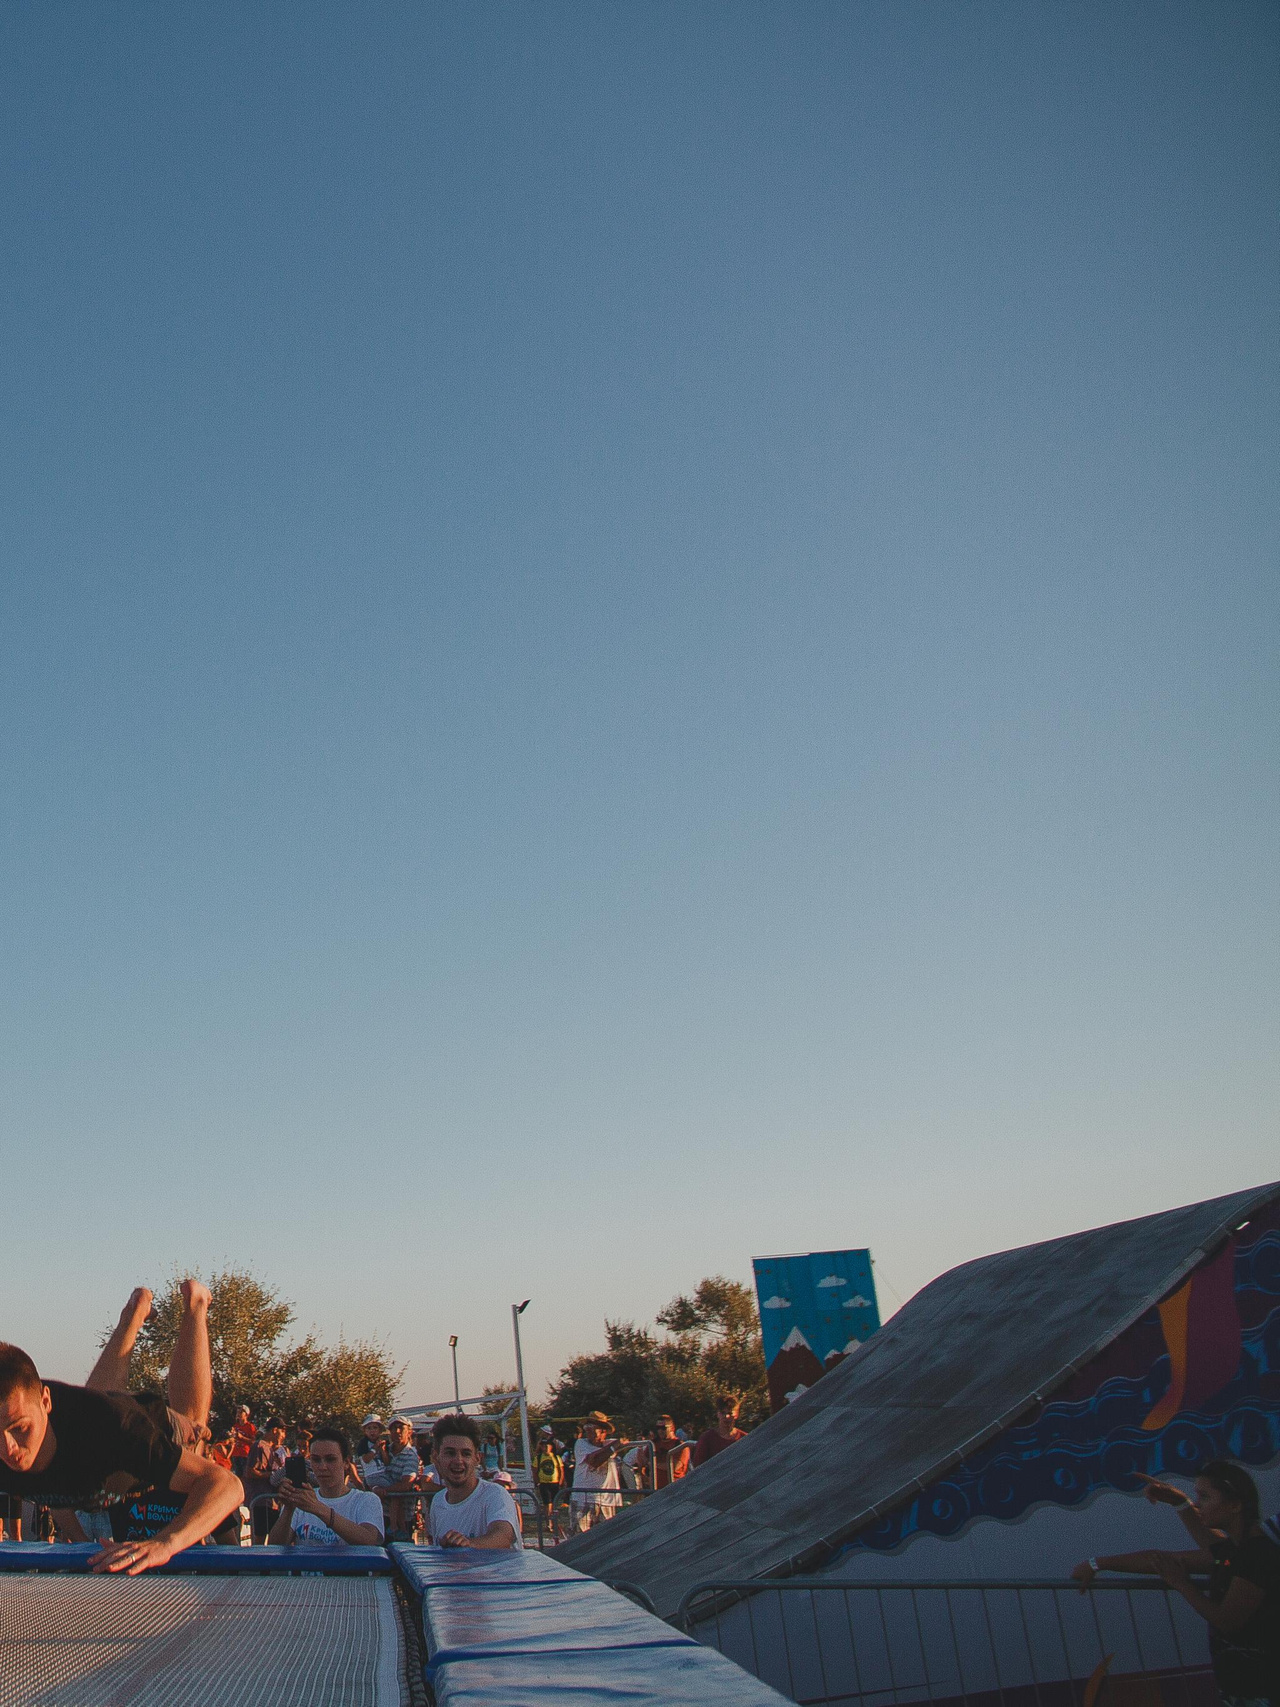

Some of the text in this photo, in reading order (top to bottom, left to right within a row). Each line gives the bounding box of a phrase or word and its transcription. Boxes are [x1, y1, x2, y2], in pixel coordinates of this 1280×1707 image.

[147, 1503, 183, 1515] КРЫМС
[147, 1512, 176, 1522] ВОЛН
[310, 1525, 337, 1537] КРЫМ
